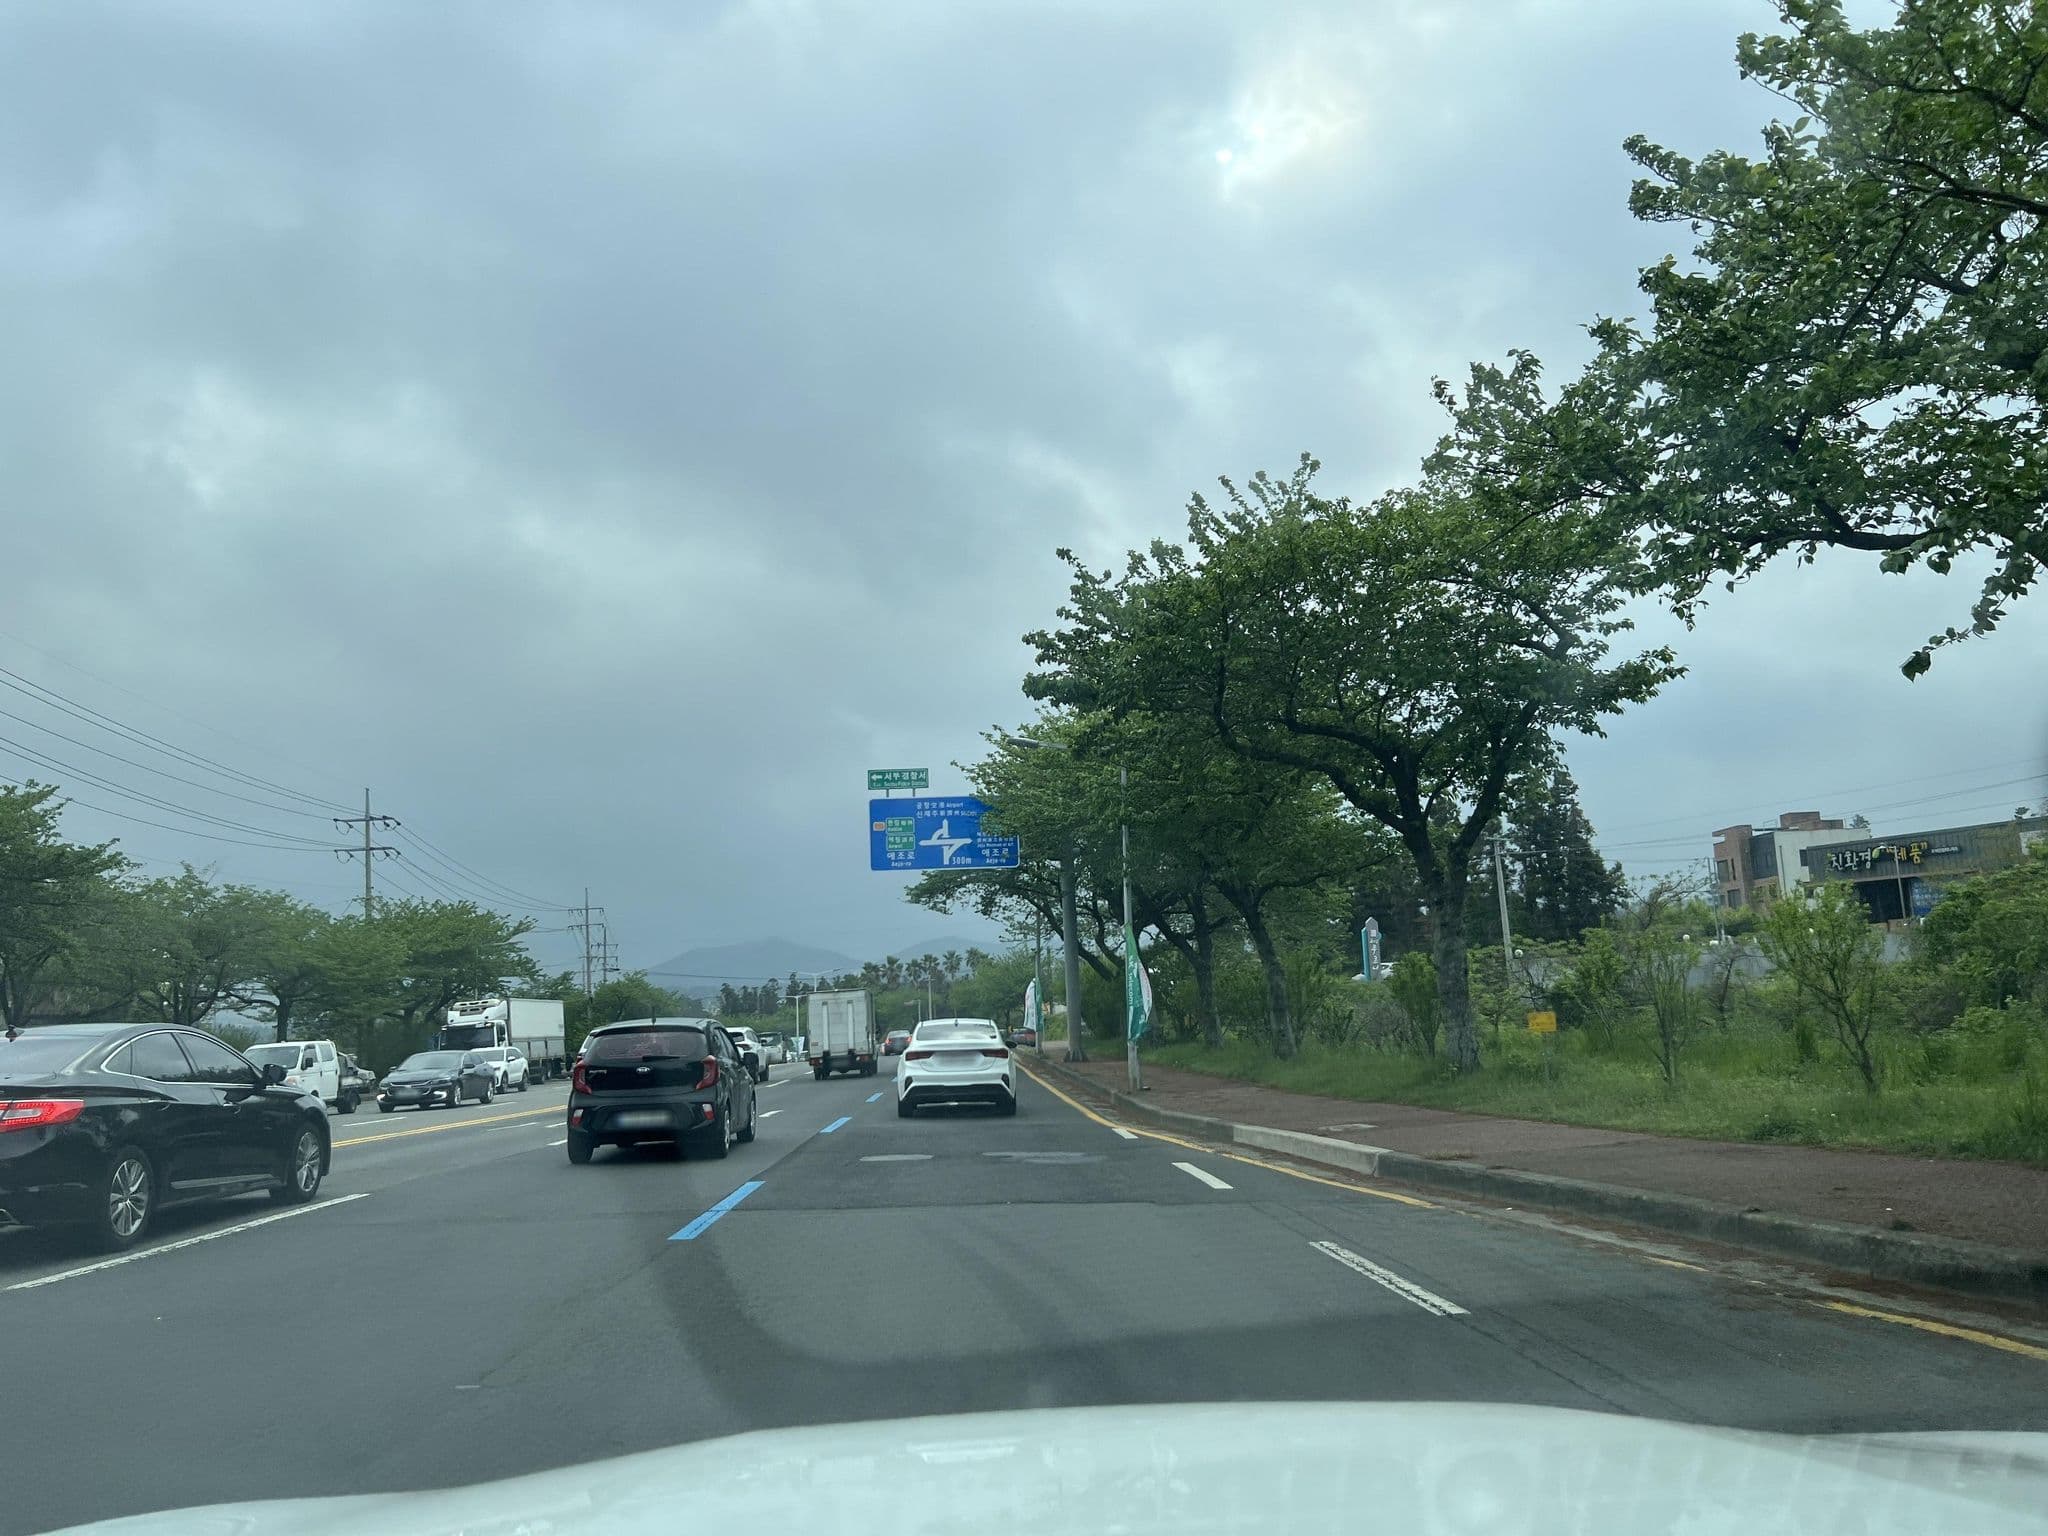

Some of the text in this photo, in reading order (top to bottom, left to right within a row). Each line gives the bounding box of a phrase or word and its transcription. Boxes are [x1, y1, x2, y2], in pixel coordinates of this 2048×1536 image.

[884, 771, 926, 781] 서부경찰서
[952, 856, 972, 865] 300m
[1831, 848, 1872, 871] 친환경
